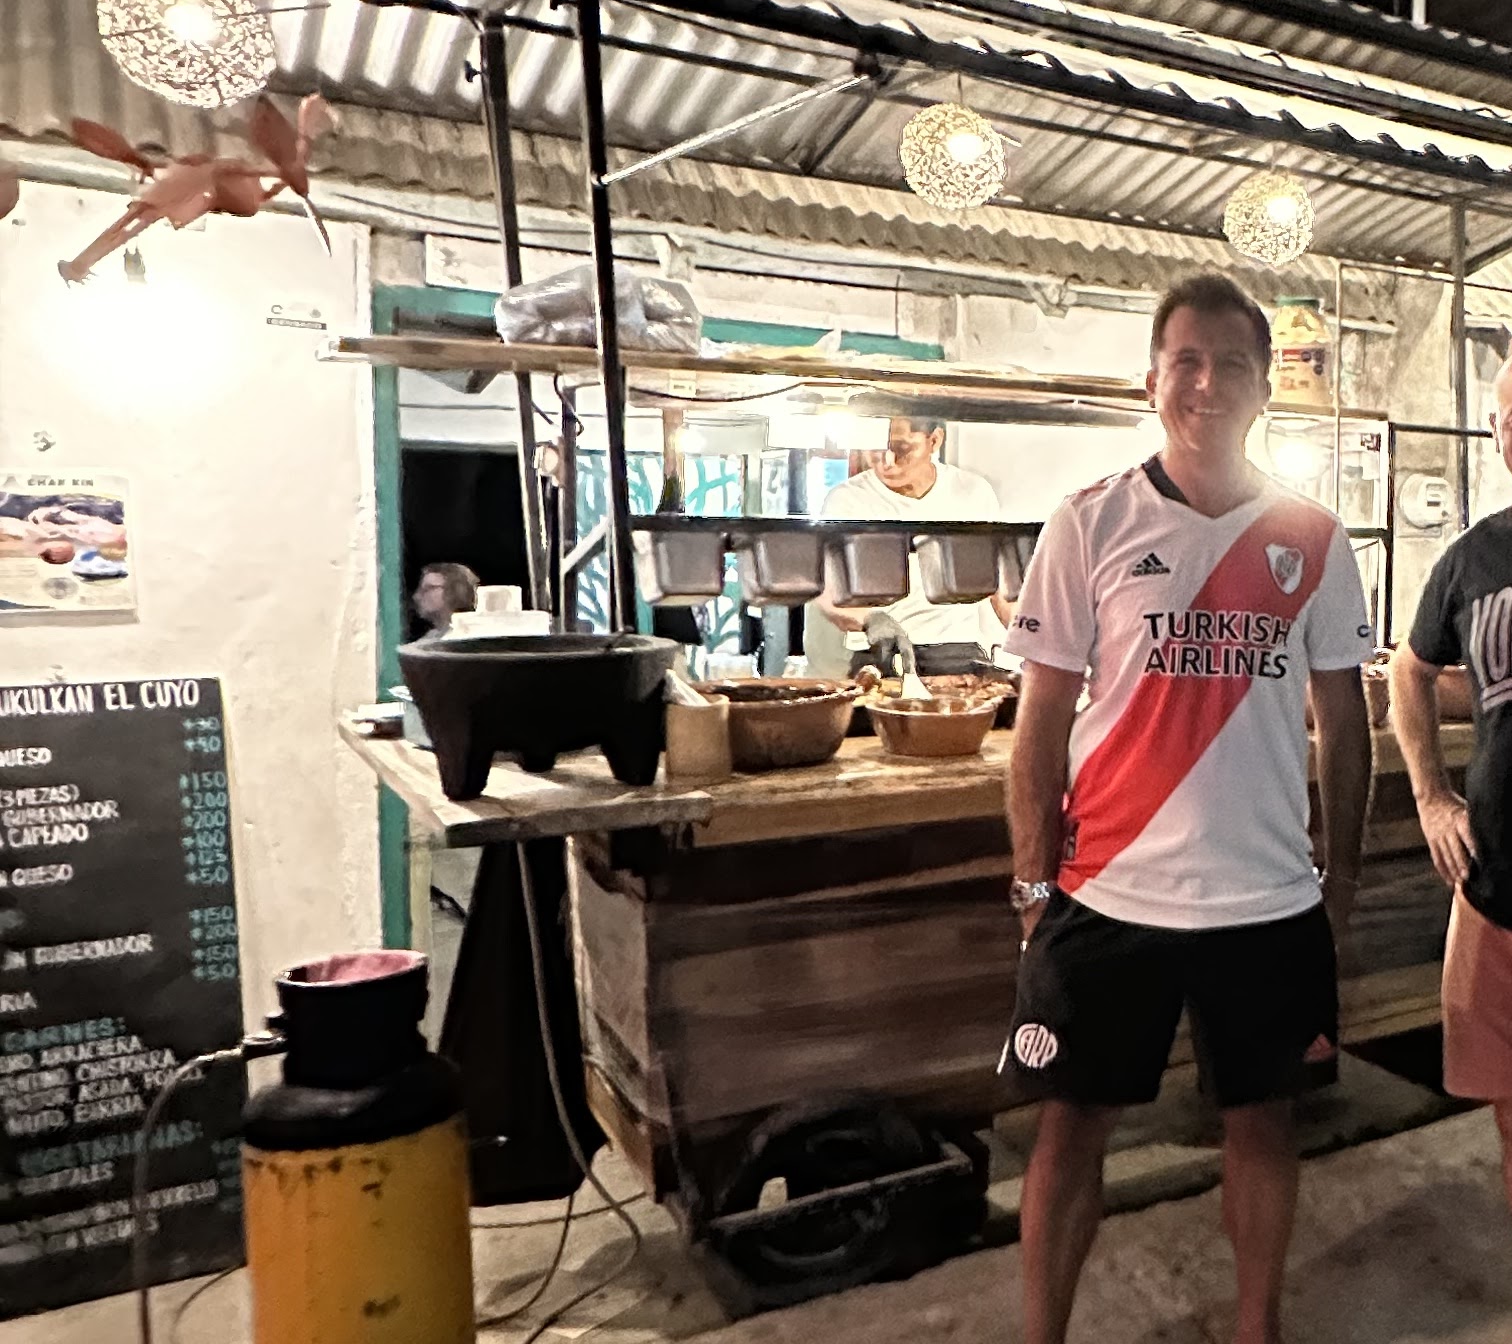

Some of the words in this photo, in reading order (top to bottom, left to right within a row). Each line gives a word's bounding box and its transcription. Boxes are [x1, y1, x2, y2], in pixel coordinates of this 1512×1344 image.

[1143, 611, 1292, 645] TURKISH
[1144, 647, 1289, 679] AIRLINES
[104, 683, 134, 711] EL
[140, 679, 200, 708] CUYO
